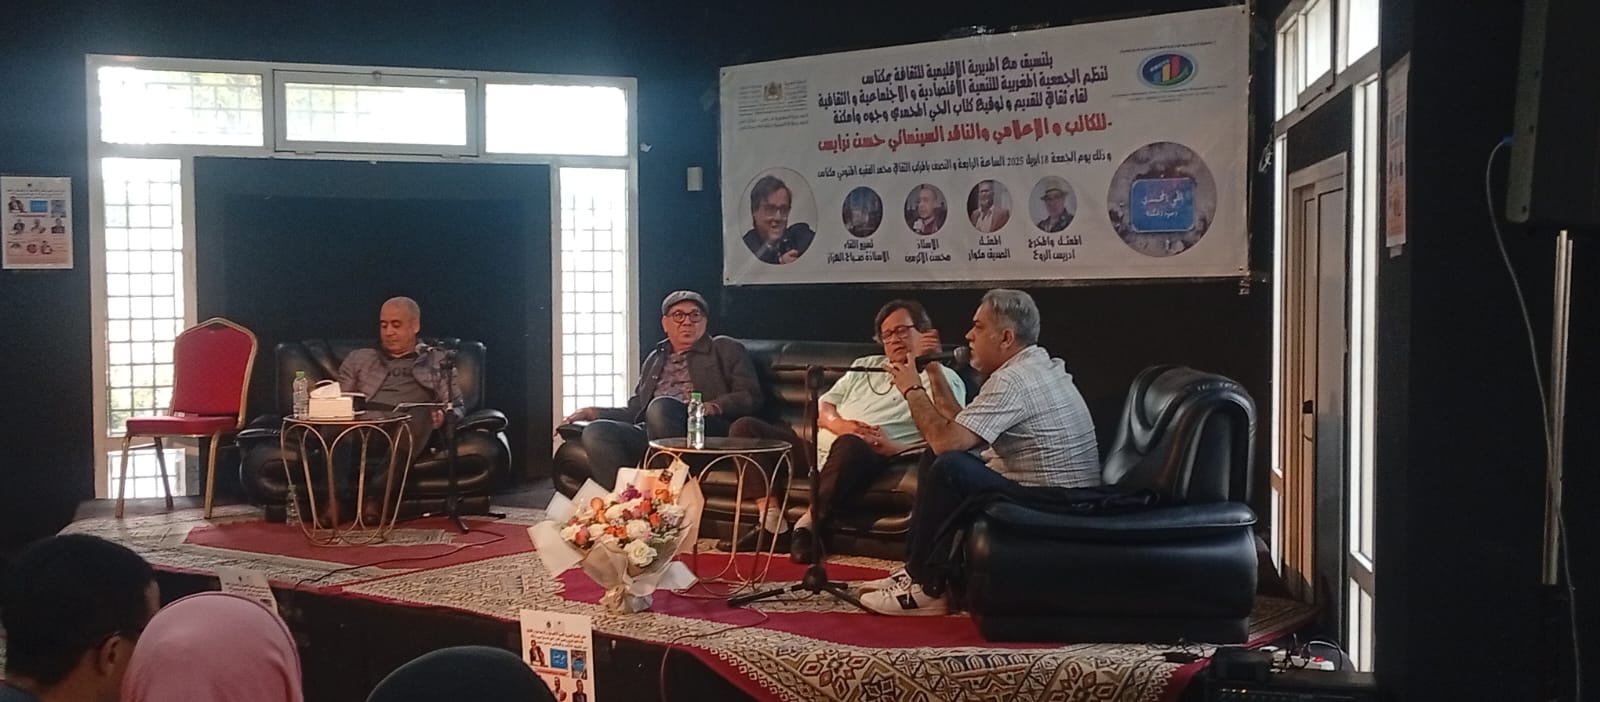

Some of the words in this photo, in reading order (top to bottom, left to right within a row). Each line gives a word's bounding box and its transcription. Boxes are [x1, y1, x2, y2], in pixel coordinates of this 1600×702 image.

[968, 56, 999, 77] المديرية
[1001, 56, 1017, 71] مع
[862, 68, 892, 85] بمكناس
[894, 64, 924, 82] للثقافة
[1039, 68, 1081, 89] الجمعية
[1082, 65, 1109, 85] تنظم
[969, 76, 999, 96] للتنمية
[1001, 72, 1037, 93] المغربية
[818, 91, 850, 110] الثقافية
[976, 95, 1004, 114] توقيع
[1014, 91, 1043, 112] لتقديم
[1045, 89, 1067, 109] ثقافي
[1070, 87, 1088, 104] لقاء
[863, 109, 889, 123] وجوه
[890, 103, 927, 122] المحمدي
[929, 100, 951, 122] الحي
[953, 97, 973, 117] كتاب
[852, 132, 885, 149] حسن
[947, 122, 990, 142] والناقد
[931, 159, 952, 171] النصف
[958, 157, 980, 171] الرابعة
[980, 155, 1005, 168] الساعة
[1051, 151, 1076, 164] الجمعة
[877, 165, 892, 174] محمد
[979, 235, 1002, 246] الممثل
[1058, 234, 1082, 246] الممثل
